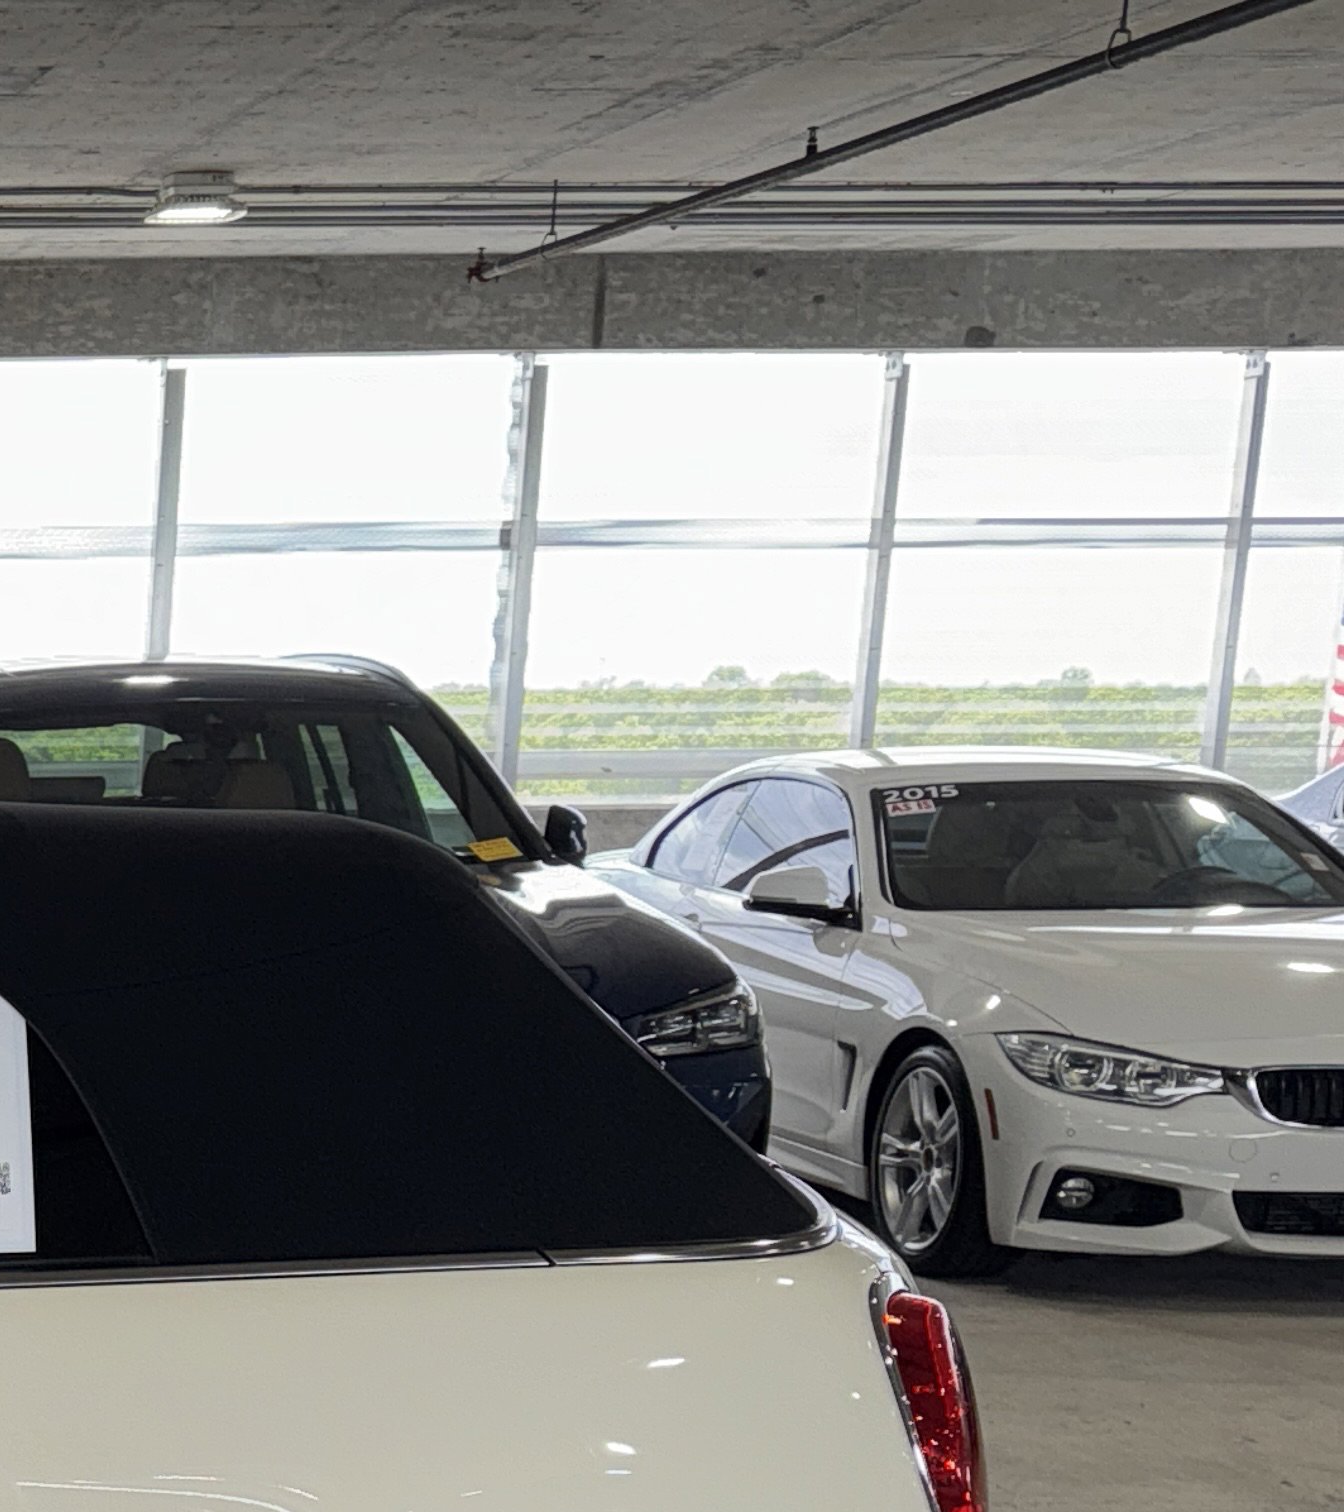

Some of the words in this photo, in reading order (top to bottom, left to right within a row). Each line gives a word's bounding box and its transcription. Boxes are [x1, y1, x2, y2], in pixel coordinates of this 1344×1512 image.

[882, 784, 959, 803] 2015
[892, 802, 912, 812] AS
[917, 800, 932, 810] IS
